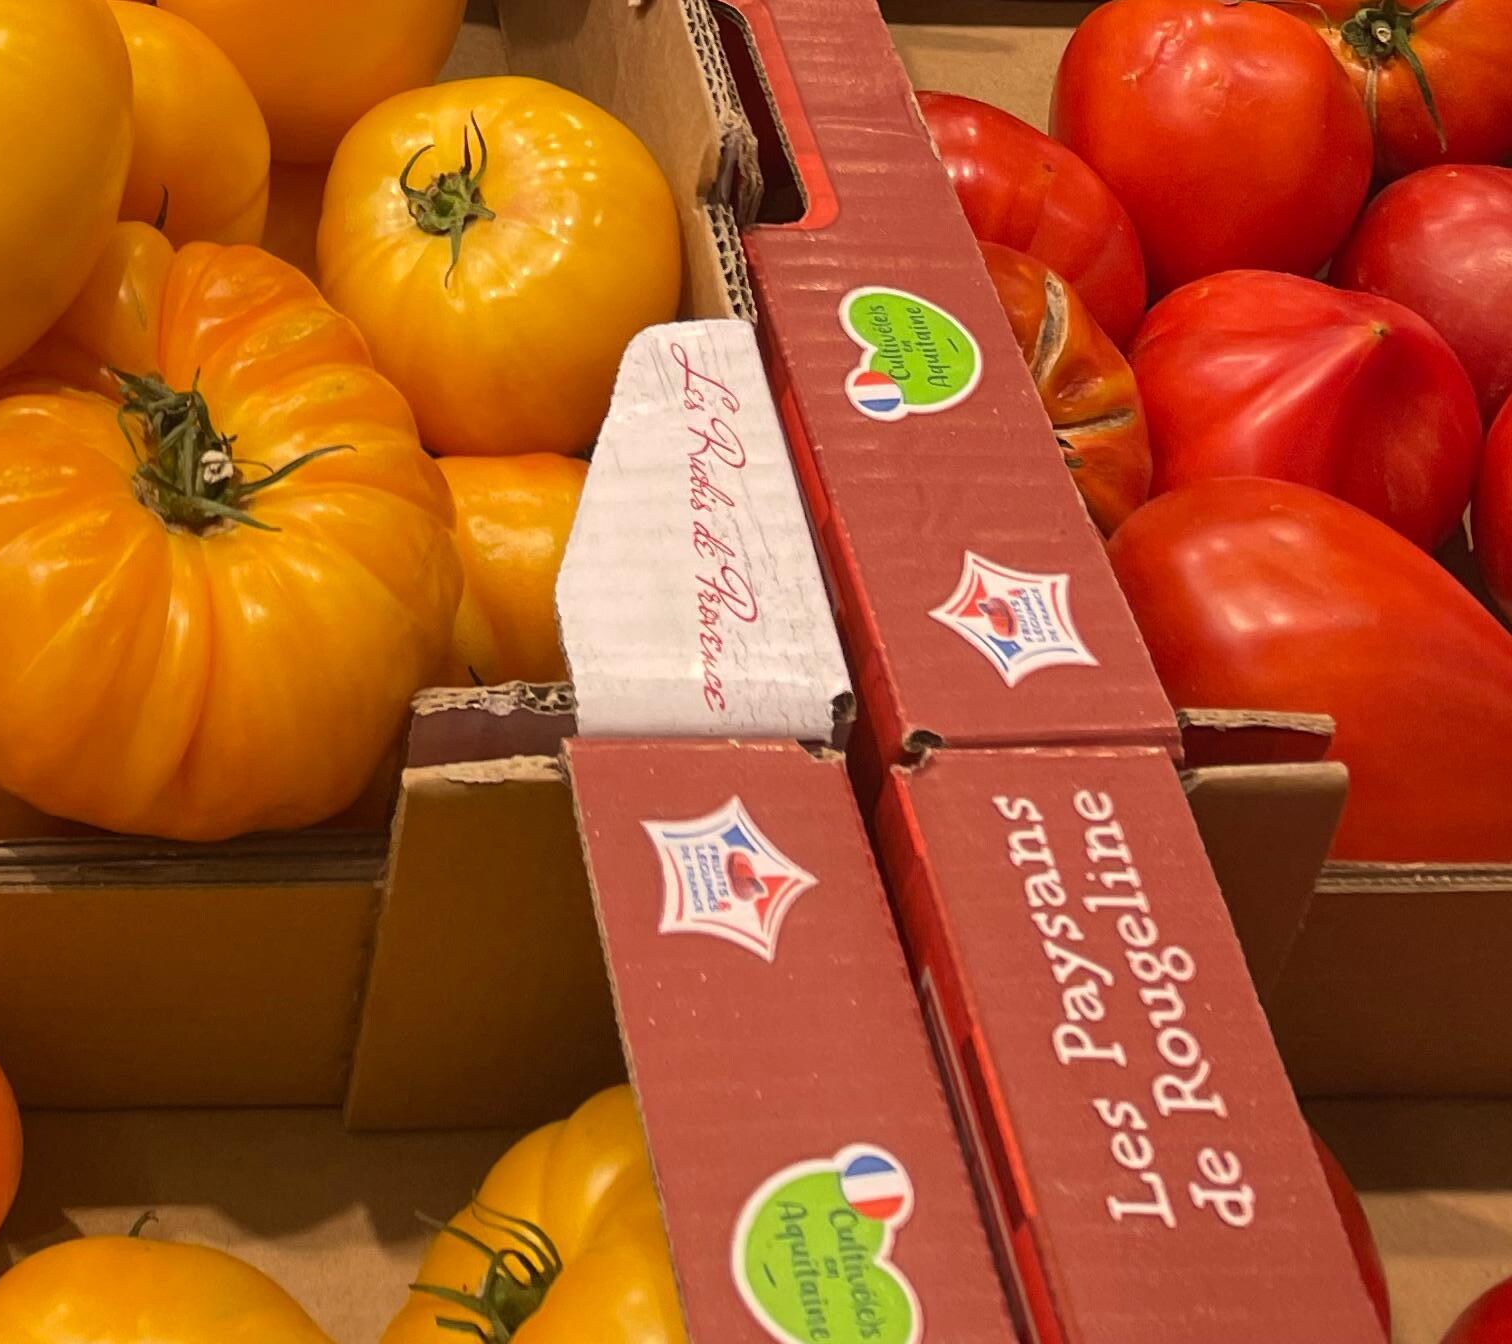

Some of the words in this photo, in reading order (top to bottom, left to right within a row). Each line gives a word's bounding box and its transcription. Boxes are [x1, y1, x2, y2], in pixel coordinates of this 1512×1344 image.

[670, 342, 740, 412] Les
[901, 340, 914, 353] en
[906, 306, 953, 388] Aquitaine
[686, 416, 747, 512] Rubis
[692, 520, 737, 571] de
[693, 564, 758, 713] Provence
[1010, 599, 1034, 643] FRUITS
[1030, 586, 1053, 627] FRANCE
[1047, 629, 1061, 643] DE
[680, 843, 692, 862] DE
[686, 864, 705, 914] FRANCE
[707, 842, 730, 898] FRUITS
[994, 794, 1127, 1068] Paysans
[1073, 788, 1227, 1119] Rougeline
[1092, 1097, 1176, 1229] Les
[1190, 1146, 1255, 1228] de
[774, 1200, 831, 1342] Aquitaine
[822, 1255, 840, 1279] en
